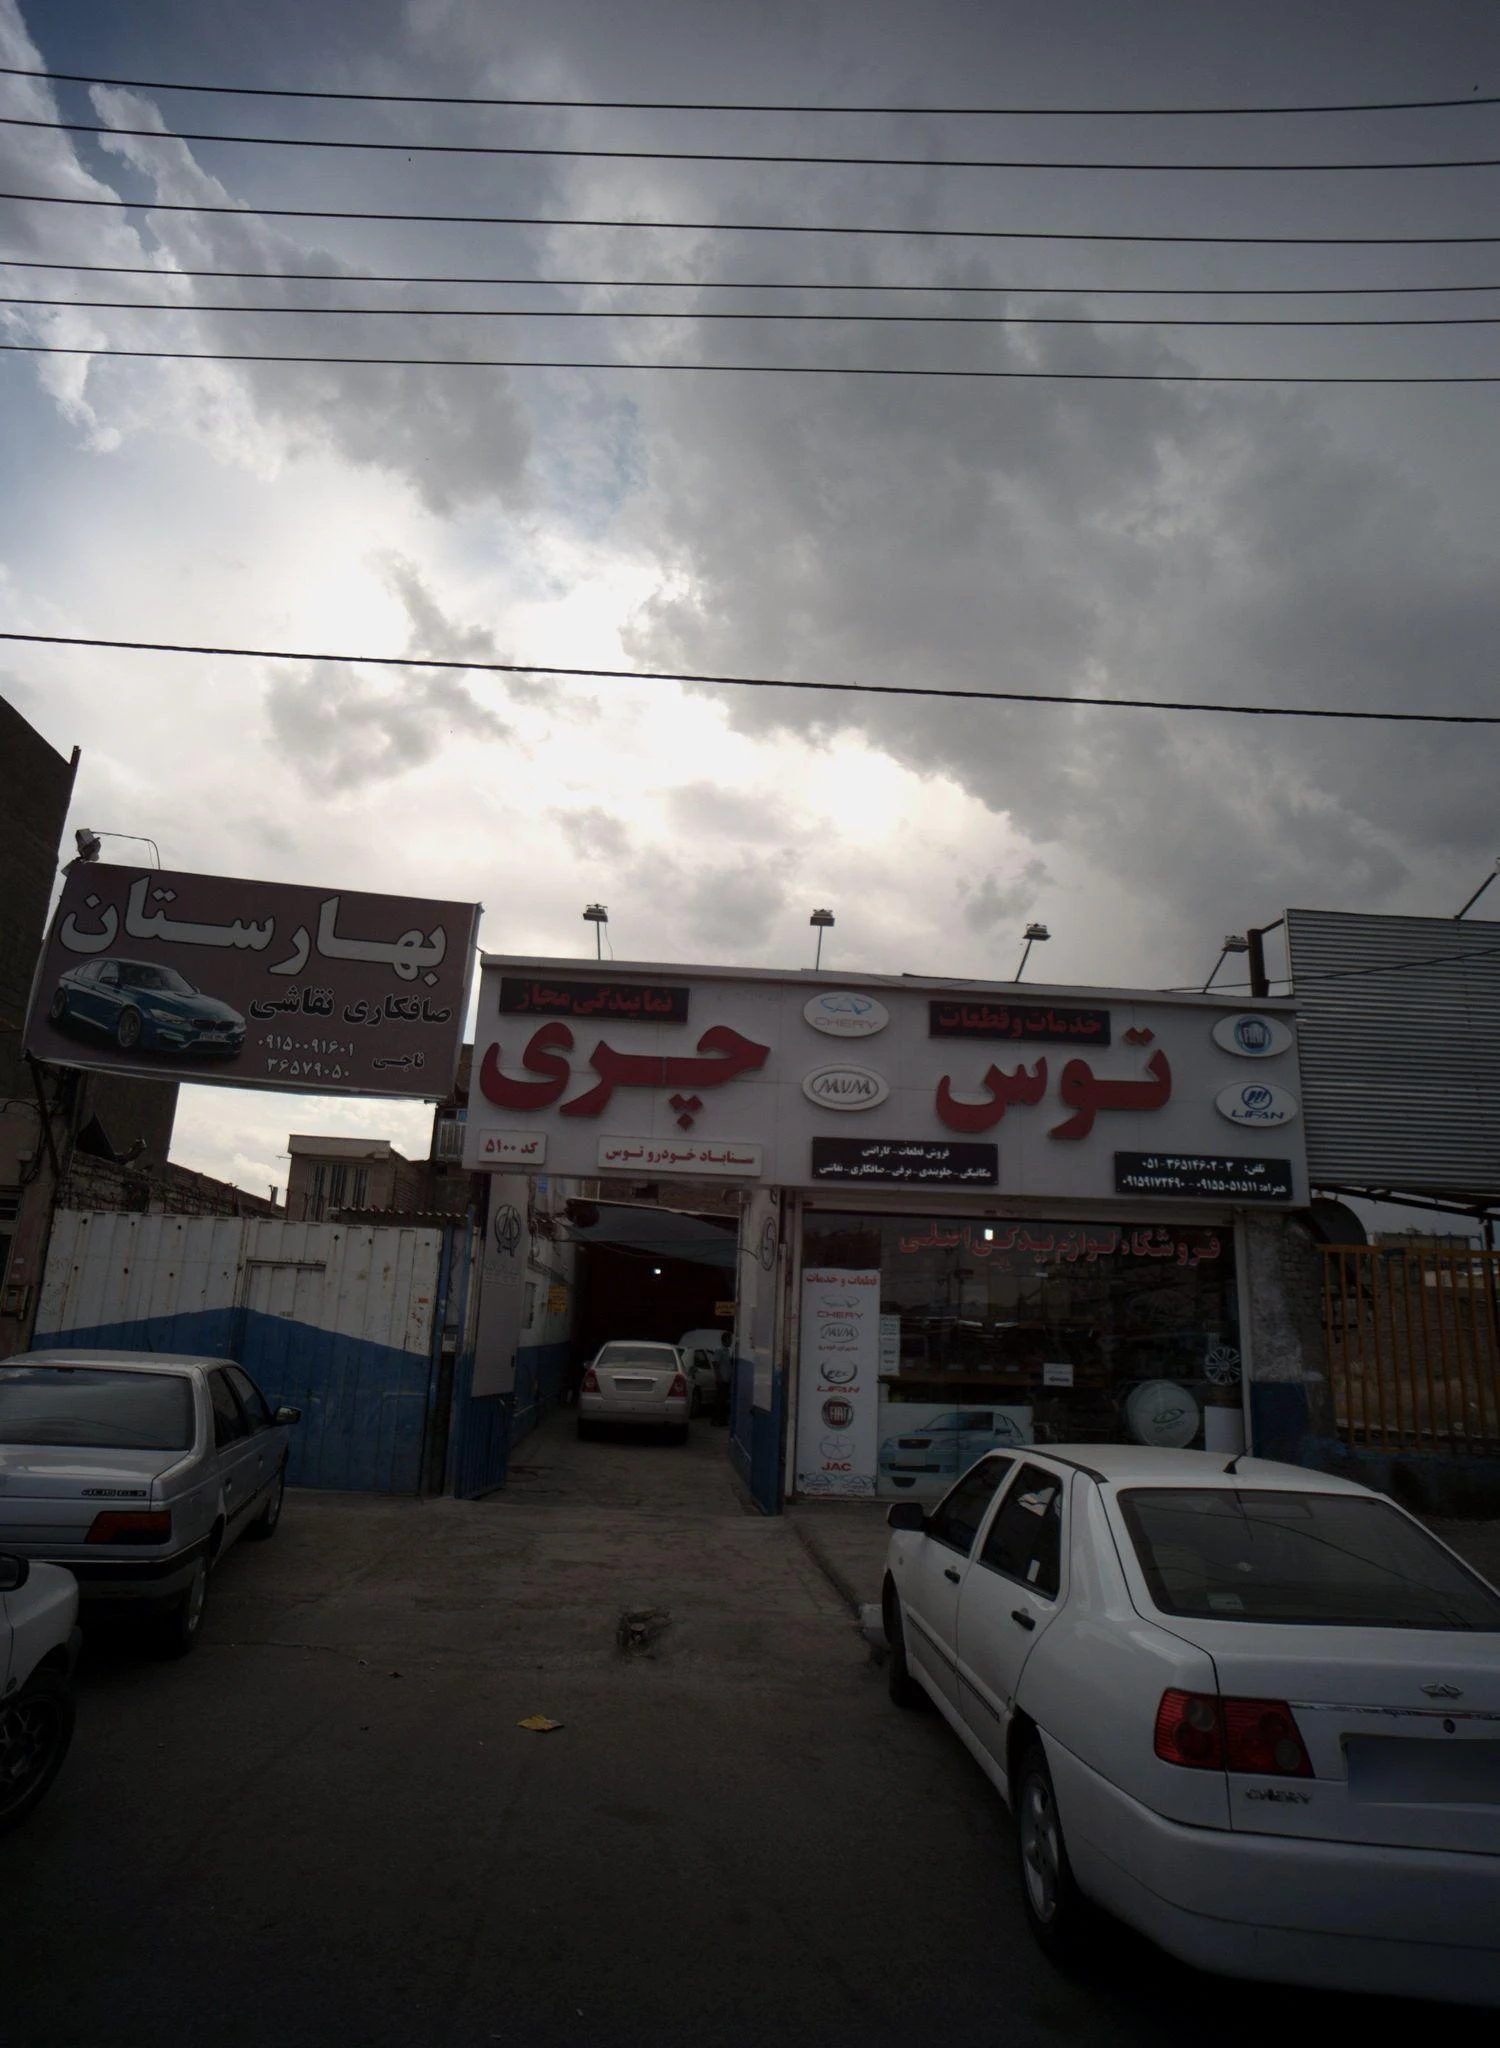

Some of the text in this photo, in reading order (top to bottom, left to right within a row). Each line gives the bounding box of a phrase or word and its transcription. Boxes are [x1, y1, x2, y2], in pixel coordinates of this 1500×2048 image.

[59, 875, 447, 986] بهارستان
[250, 985, 452, 1025] صافکاری نقاشی
[515, 980, 673, 1018] نمایندگی مجاز
[815, 1017, 879, 1029] CHERY
[939, 1004, 1104, 1038] خدمات و قطعات
[257, 1033, 355, 1057] ۰۹۱۵۰۰۹۱۶۰۱
[266, 1057, 350, 1079] ۳۶۵۷۹۰۵۰
[371, 1052, 426, 1073] ناجی
[480, 1022, 770, 1131] چری
[936, 1026, 1173, 1139] توس
[818, 1078, 871, 1095] MVM
[1231, 1110, 1284, 1119] LIFAN
[485, 1138, 539, 1154] کد ۵۱۰۰
[605, 1146, 644, 1161] توس
[899, 1146, 924, 1156] قطعات
[925, 1147, 950, 1160] فروش
[647, 1148, 695, 1164] خودرو
[819, 1162, 992, 1179] مکانیکی جلوبندی برقی صافکاری نقاشی
[900, 1222, 972, 1254] اصلی
[973, 1225, 1055, 1263] یدکی
[1055, 1231, 1116, 1264] لوازم
[1120, 1225, 1222, 1267] فروشگاه
[806, 1273, 837, 1284] خدمات
[847, 1276, 877, 1286] قطعات
[817, 1310, 863, 1319] CHERY
[822, 1461, 852, 1472] JAC
